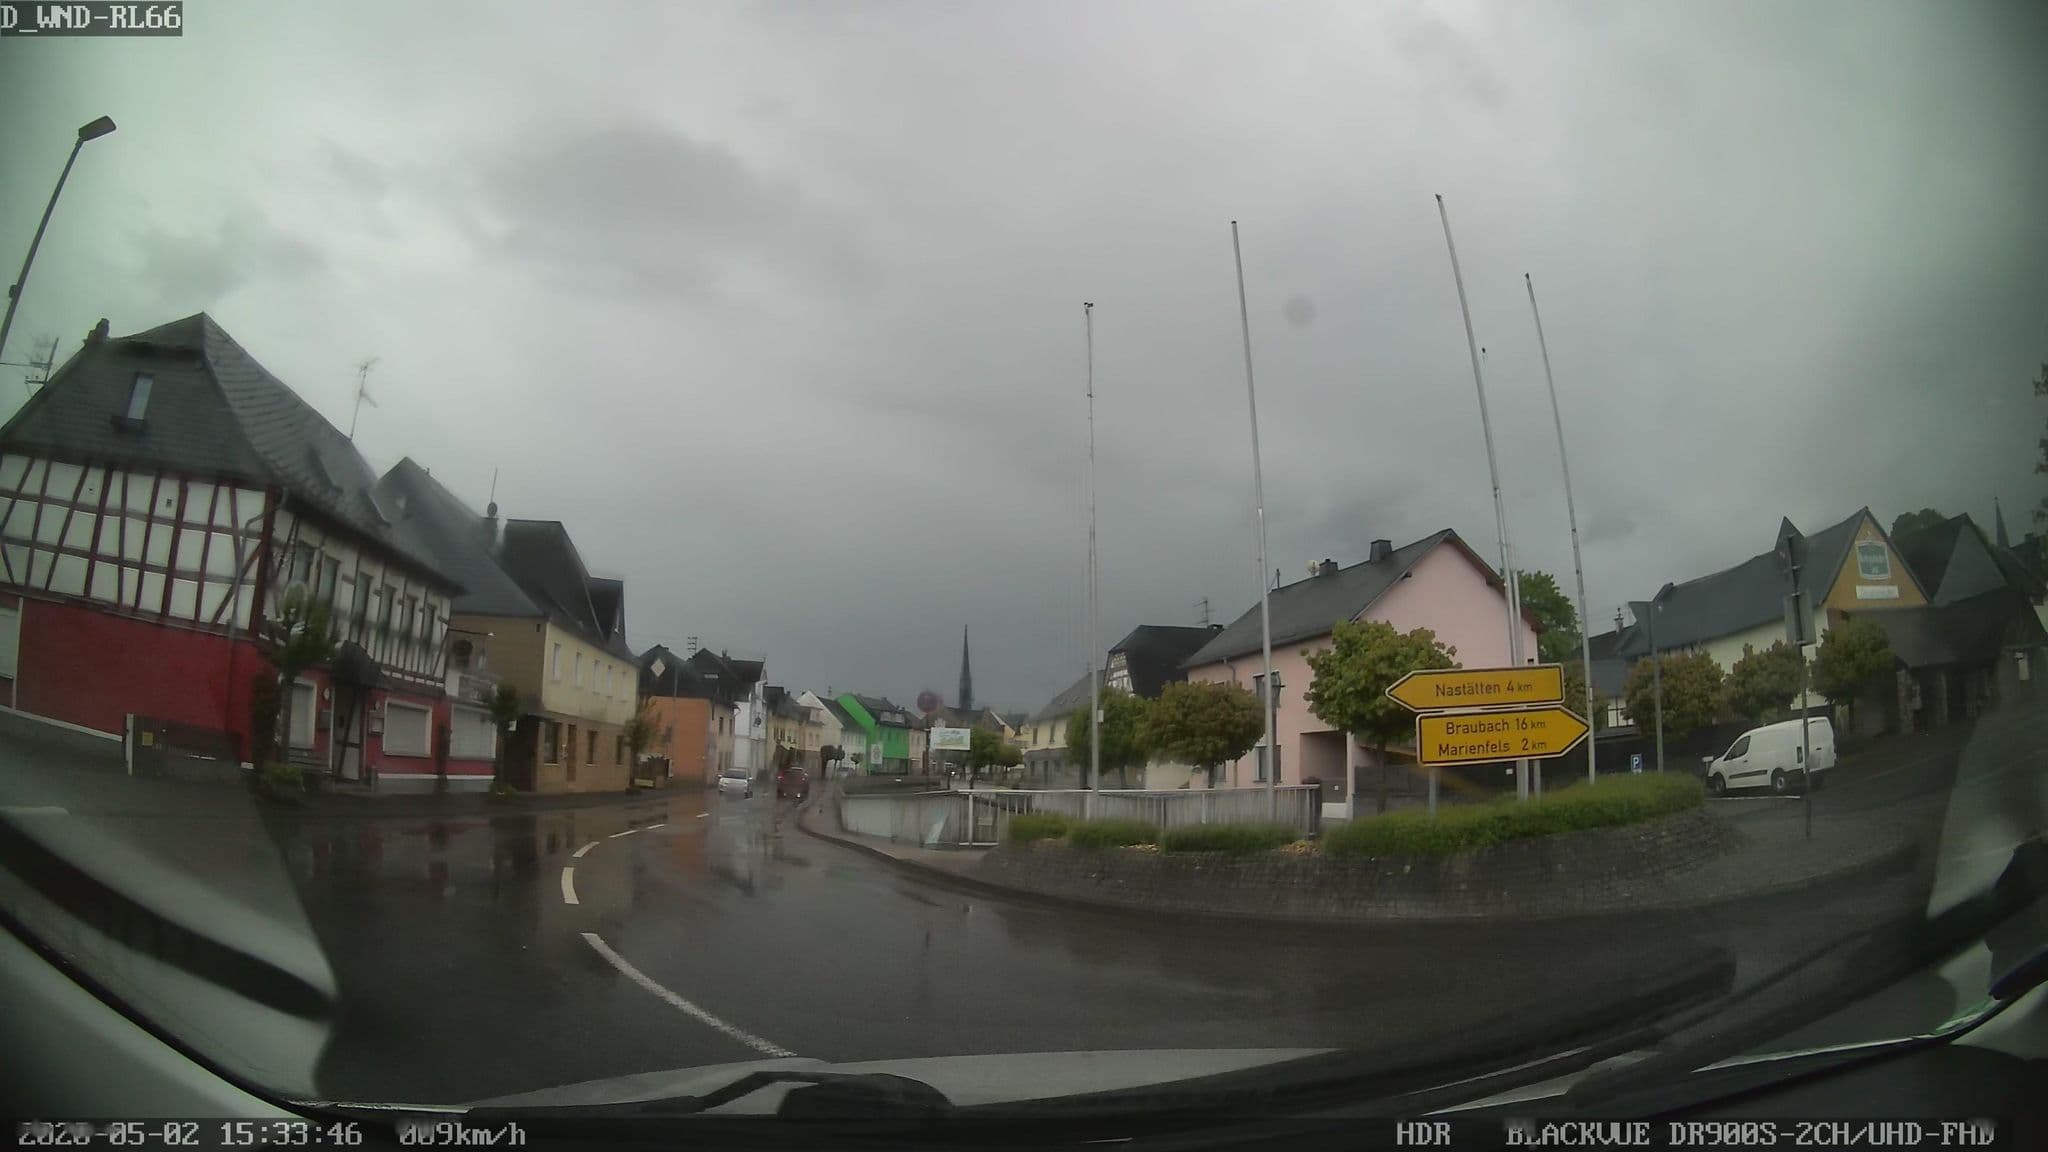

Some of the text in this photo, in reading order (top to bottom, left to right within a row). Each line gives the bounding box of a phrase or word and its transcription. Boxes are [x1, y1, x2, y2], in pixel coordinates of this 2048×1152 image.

[1435, 681, 1533, 697] Nastätten 4 km
[1446, 718, 1546, 735] Braubach 16 km
[1438, 738, 1547, 757] Marienfels 2 km
